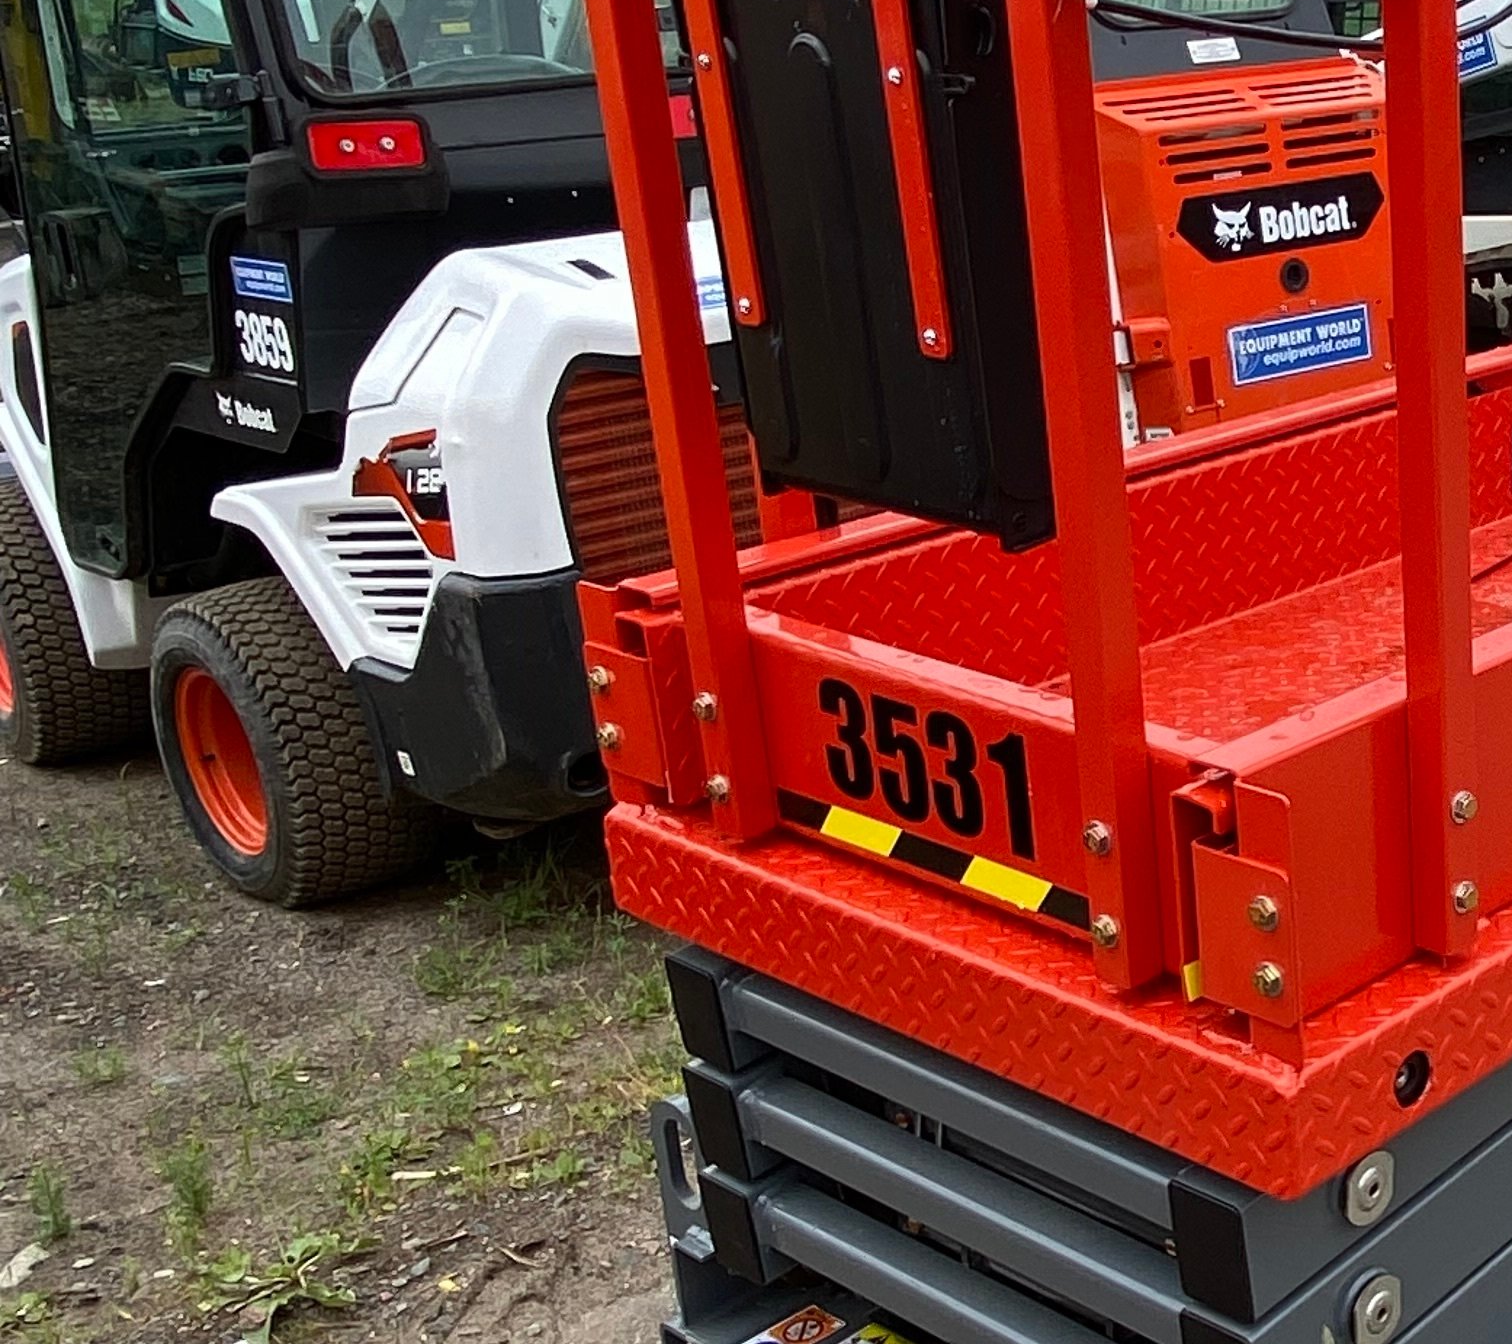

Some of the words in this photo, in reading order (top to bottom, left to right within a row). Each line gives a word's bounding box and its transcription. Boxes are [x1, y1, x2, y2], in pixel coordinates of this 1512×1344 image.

[1258, 195, 1352, 244] Bobcat
[234, 309, 295, 373] 3859
[1239, 328, 1312, 355] EQUIPMENT
[1316, 318, 1362, 340] WORLD
[1263, 335, 1362, 367] equipworld.com
[818, 677, 1036, 862] 3531
